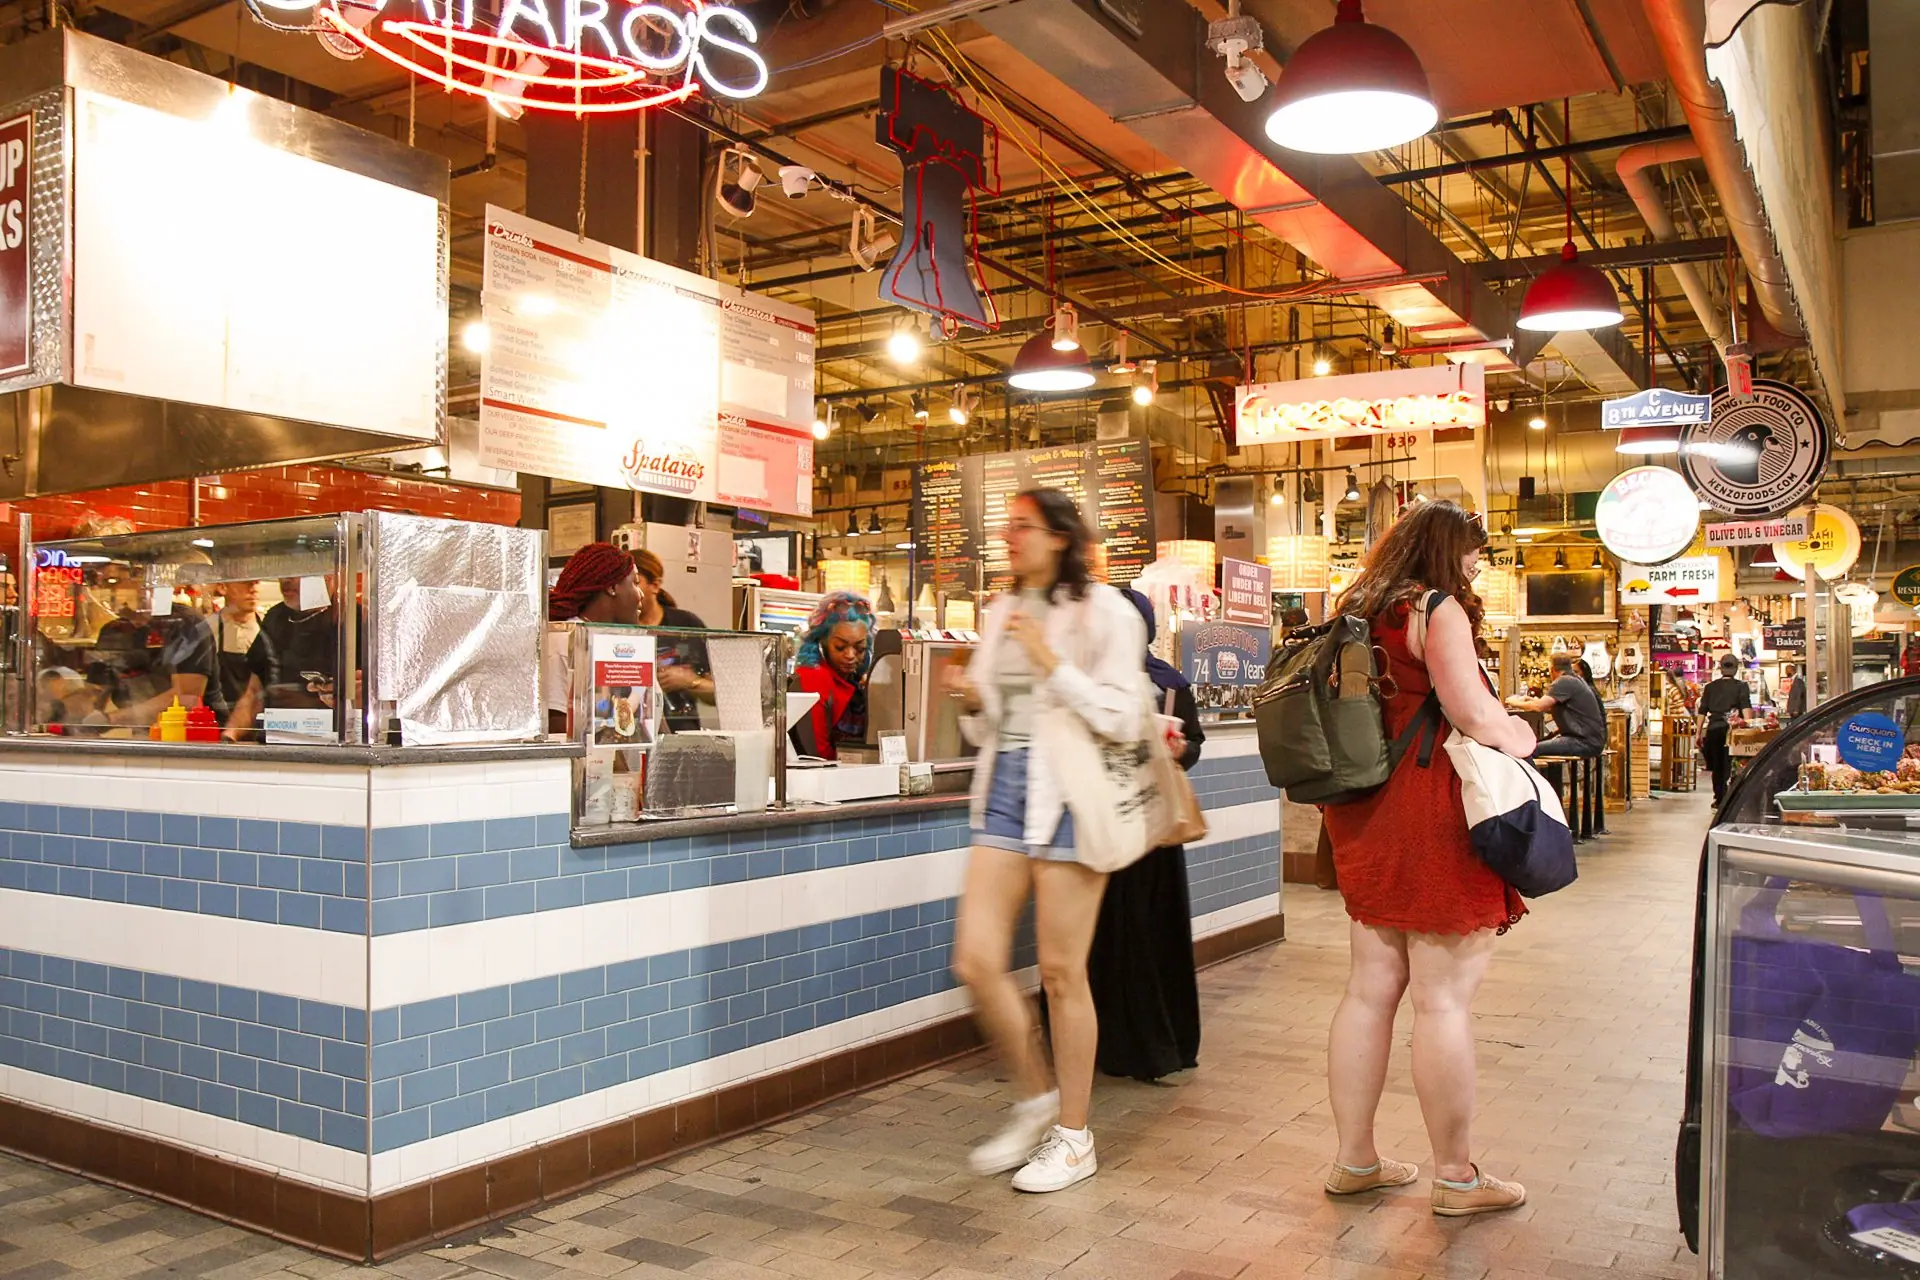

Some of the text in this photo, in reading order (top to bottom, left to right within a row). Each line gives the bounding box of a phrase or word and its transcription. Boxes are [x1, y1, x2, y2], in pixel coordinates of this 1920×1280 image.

[491, 219, 534, 249] Drinks
[1647, 390, 1661, 407] C
[1639, 403, 1705, 419] AVENUE
[1762, 395, 1792, 413] FOOD
[1789, 410, 1805, 430] CO.
[1386, 434, 1417, 458] 839
[622, 439, 705, 480] Spataro's
[1707, 472, 1798, 501] KENZOFOODS.COM
[1709, 523, 1804, 542] OLIVE OIL & VINEGAR
[1238, 563, 1258, 578] ORDER
[1648, 568, 1715, 582] FARM FRESH
[1231, 576, 1264, 593] UNDER THE
[1227, 590, 1268, 608] LIBERTY BELL
[1194, 626, 1260, 658] CELEBRATING
[1775, 637, 1806, 649] Bakery
[1193, 658, 1210, 682] 74
[1242, 659, 1266, 681] Years
[1848, 721, 1897, 739] foursquare
[1847, 735, 1894, 749] CHECK IN
[1856, 743, 1883, 755] HERE
